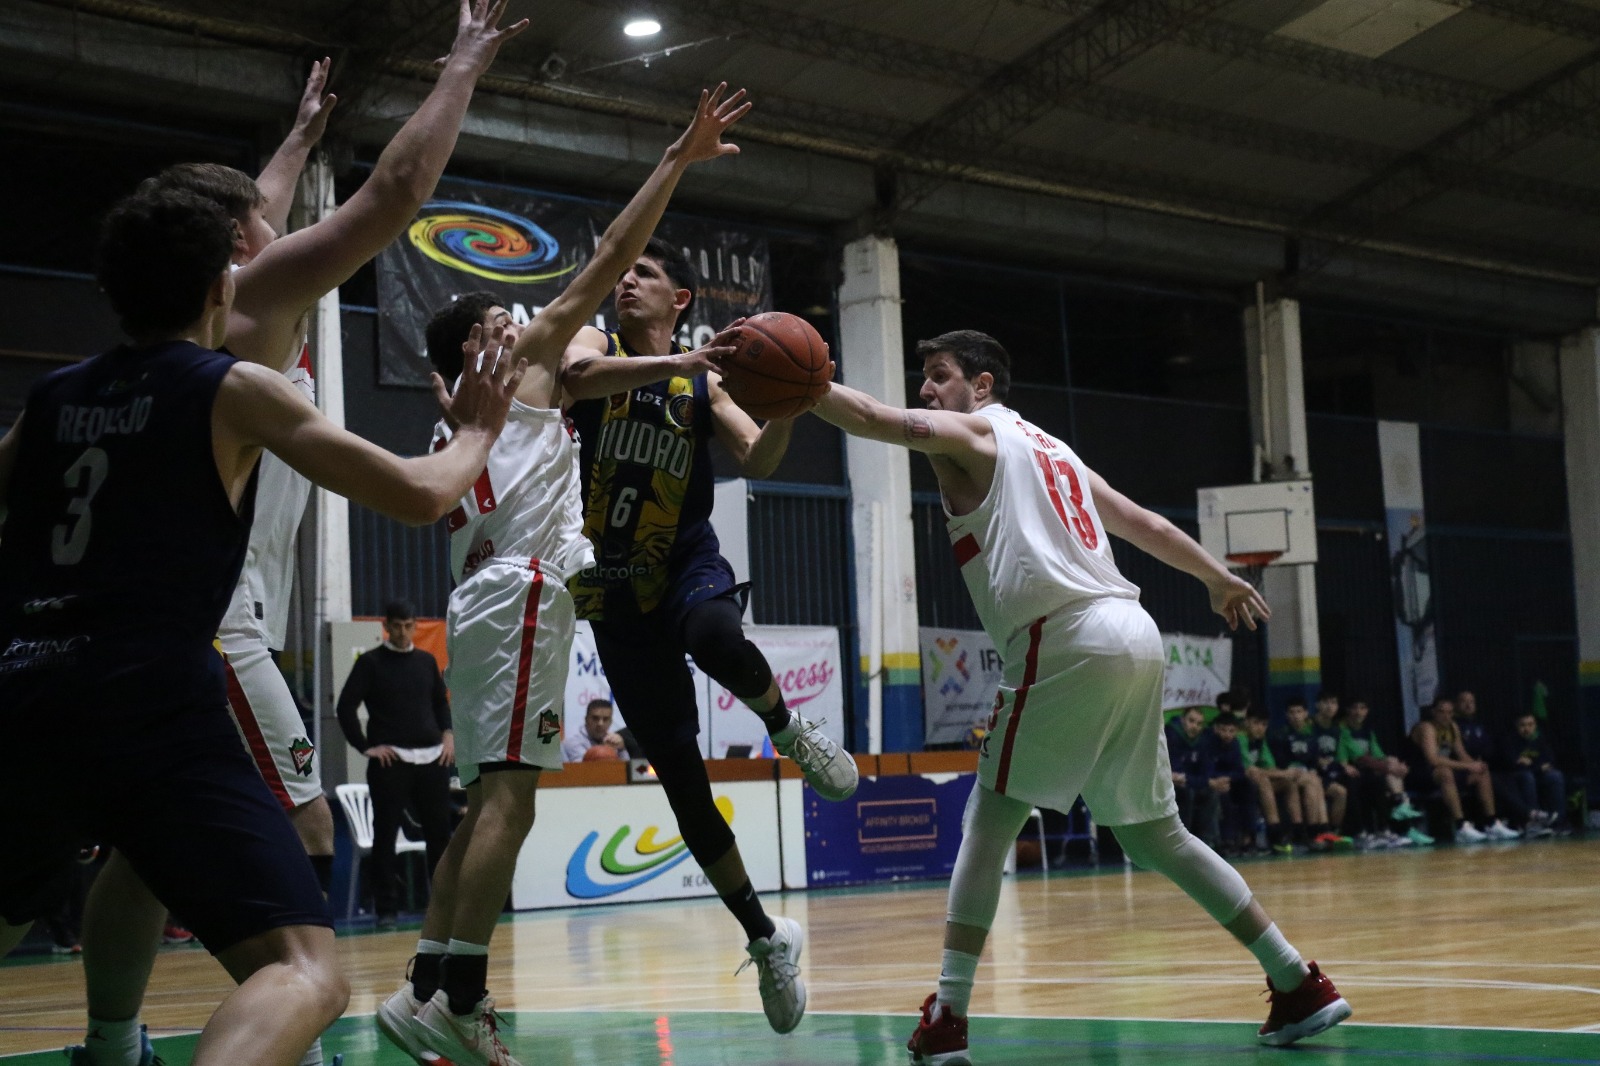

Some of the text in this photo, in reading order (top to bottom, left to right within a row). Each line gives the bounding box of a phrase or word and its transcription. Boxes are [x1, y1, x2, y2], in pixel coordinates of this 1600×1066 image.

[52, 447, 109, 566] 3
[611, 486, 638, 528] 6
[1033, 448, 1098, 551] 13
